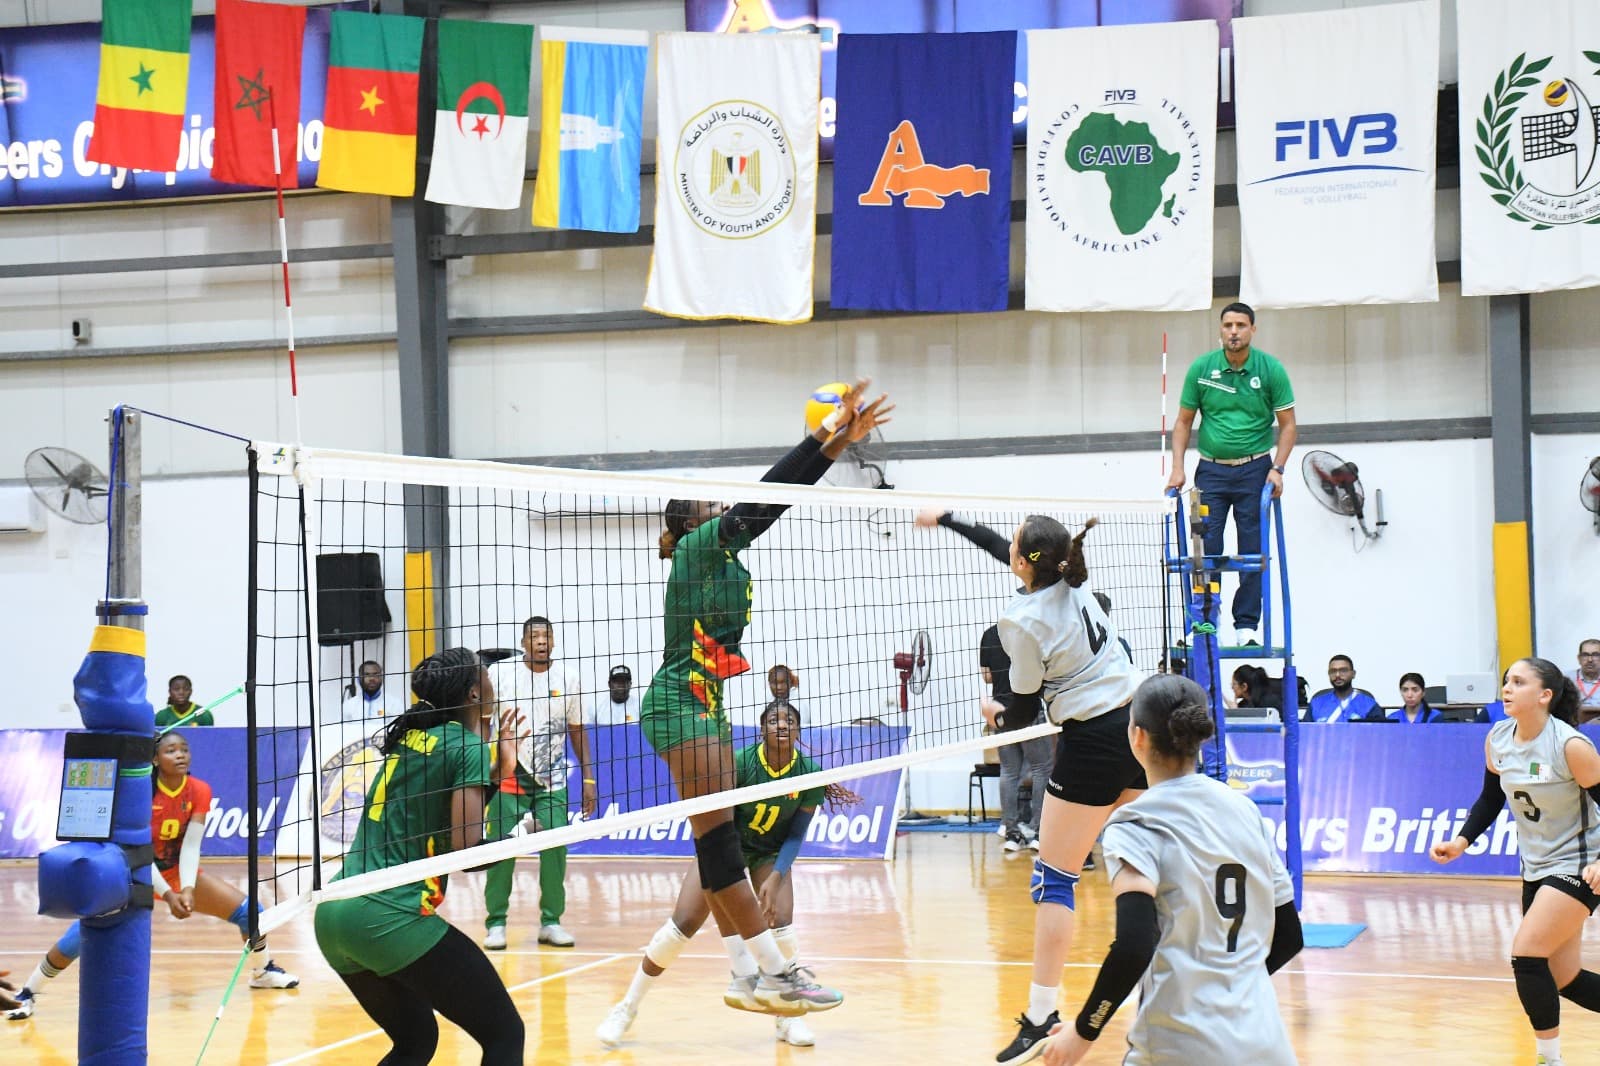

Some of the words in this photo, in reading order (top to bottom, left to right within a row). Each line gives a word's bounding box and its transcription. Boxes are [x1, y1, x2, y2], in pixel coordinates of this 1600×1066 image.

[1105, 90, 1136, 101] FIVB
[1275, 112, 1397, 162] FIVB
[1079, 145, 1153, 166] CAVB
[720, 222, 752, 233] YOUTH
[755, 212, 775, 228] AND
[1081, 605, 1108, 656] 4
[205, 797, 281, 838] hool
[748, 803, 781, 835] 11
[1514, 790, 1541, 823] 3
[160, 819, 180, 840] 9
[805, 804, 884, 843] hool
[1216, 863, 1247, 953] 9
